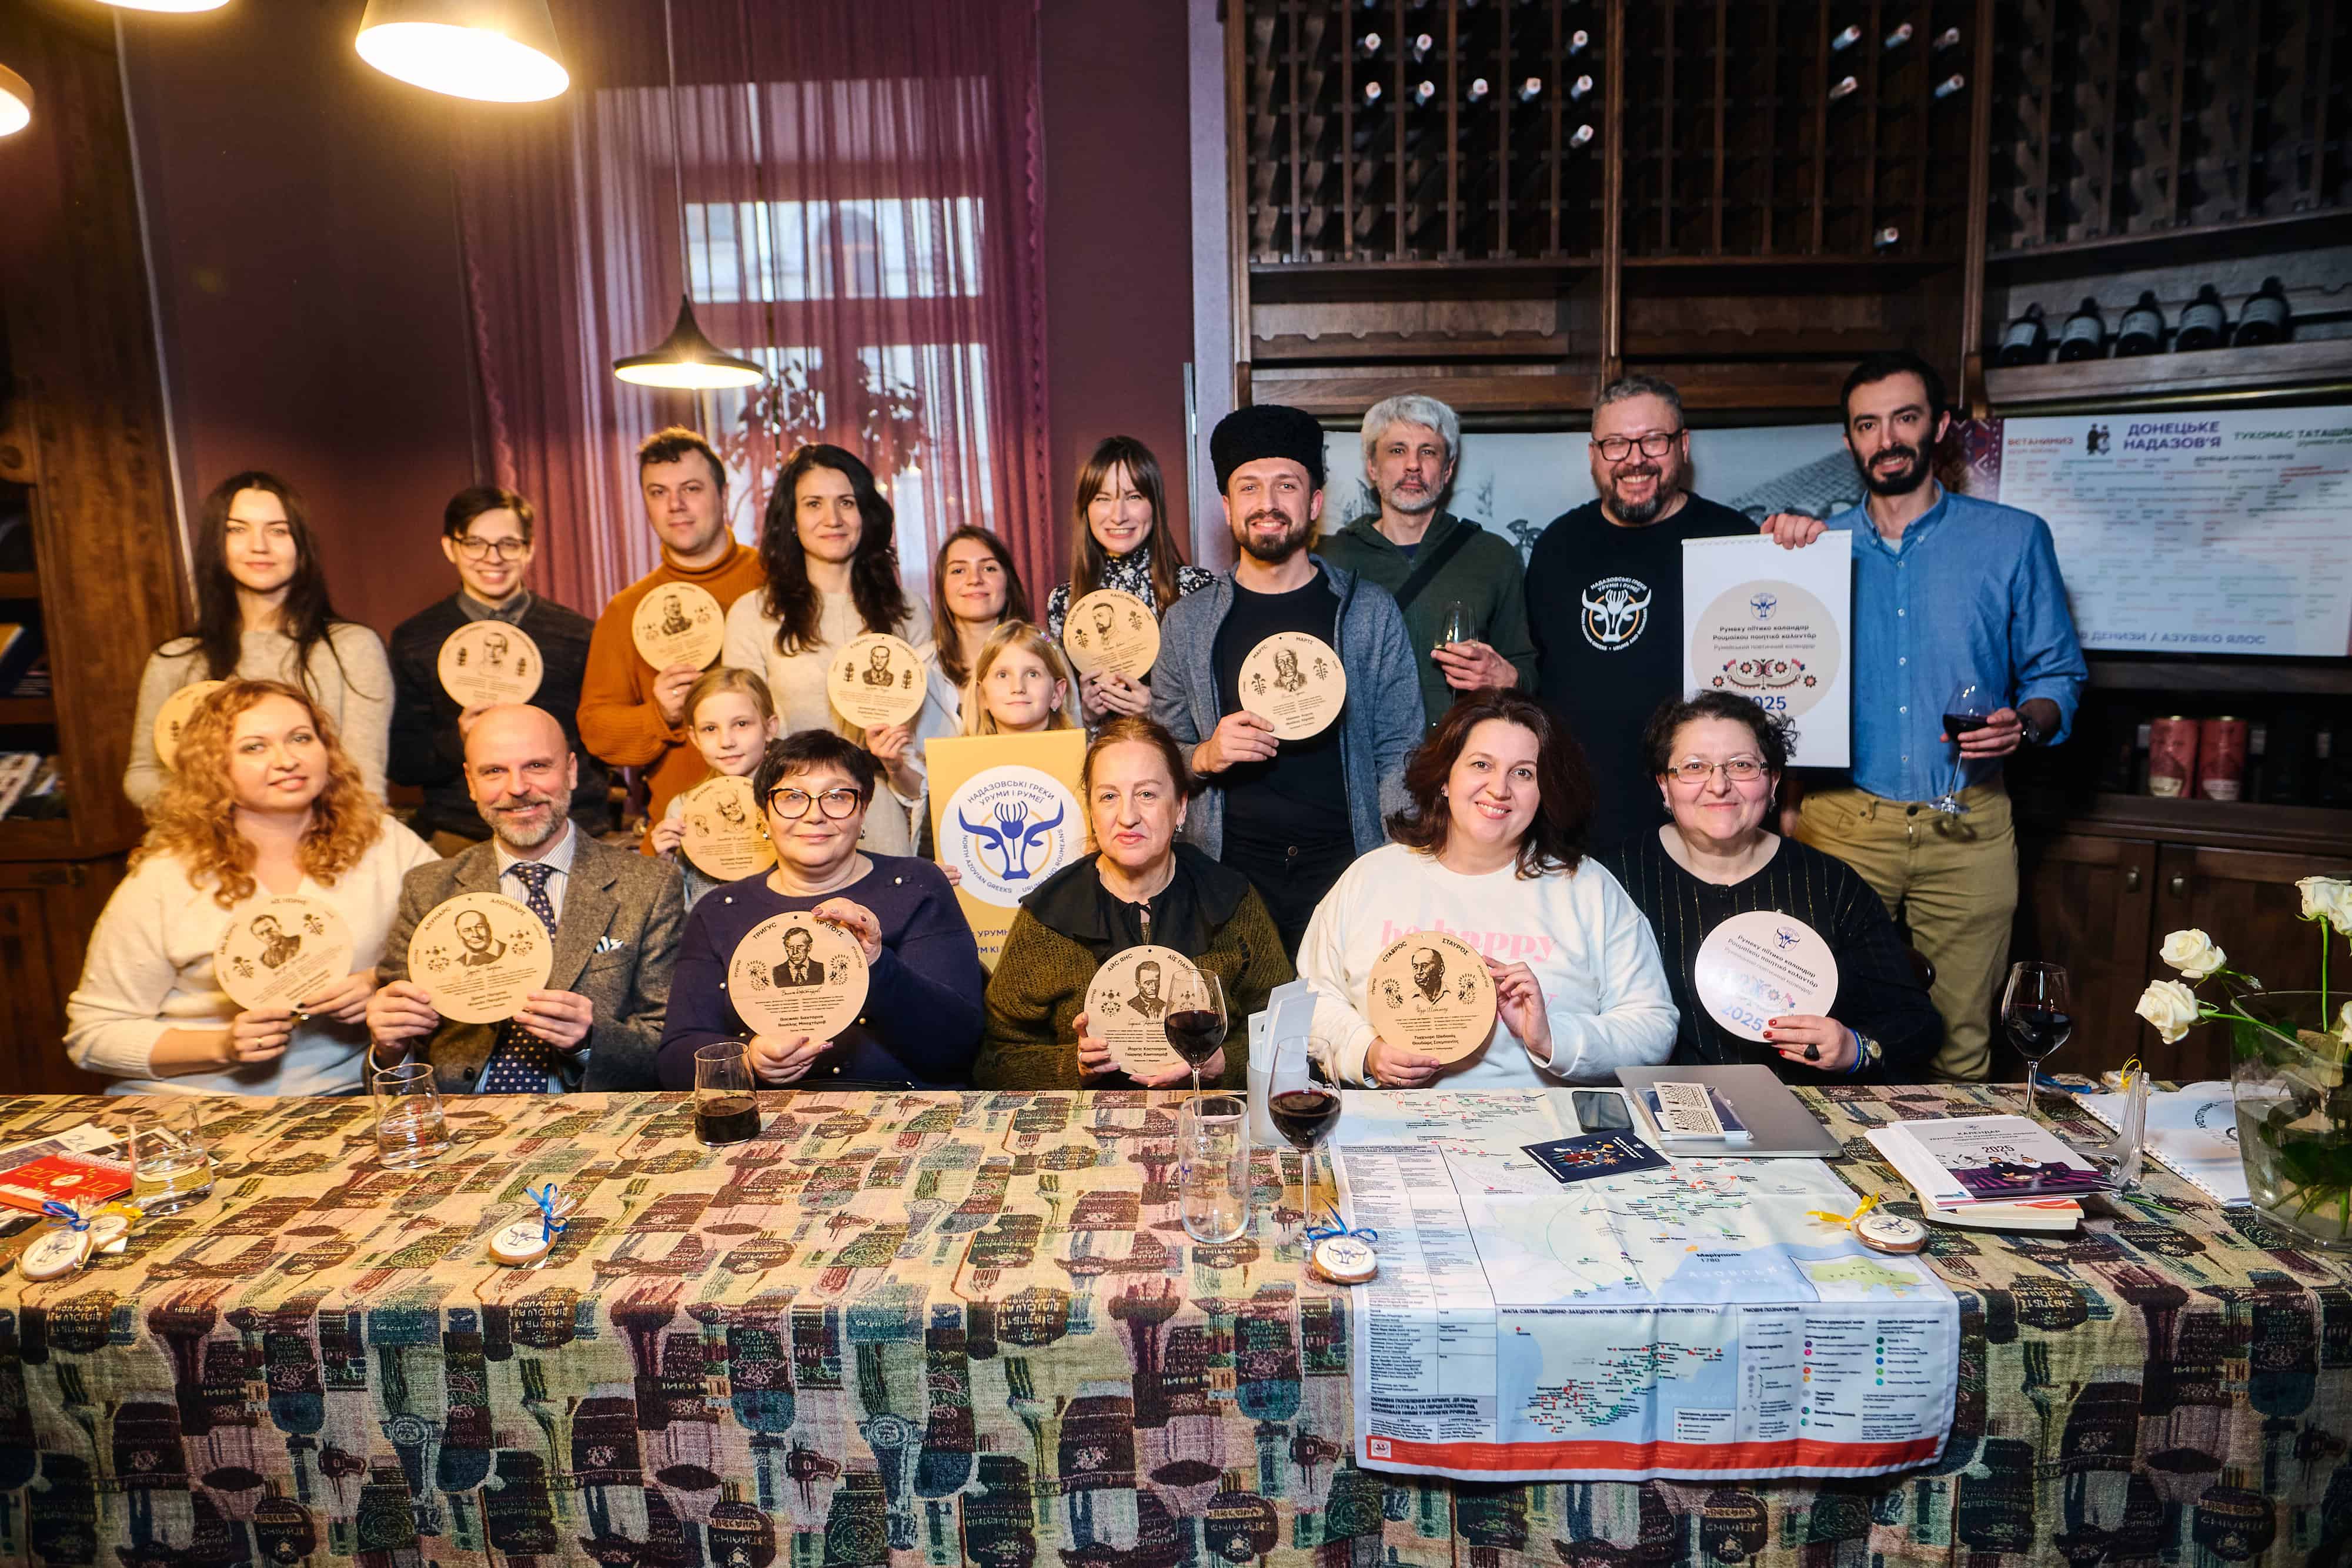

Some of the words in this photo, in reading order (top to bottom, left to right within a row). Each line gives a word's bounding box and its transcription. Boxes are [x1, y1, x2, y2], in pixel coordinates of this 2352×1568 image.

[2128, 421, 2221, 436] ДОНЕЦЬКЕ
[2124, 437, 2221, 450] НАДАЗОВ'Я
[967, 780, 1027, 805] НАДАЗОВСЬКІ
[1029, 783, 1055, 801] ГРЕКИ
[979, 790, 1010, 806] УРУМИ
[1017, 790, 1045, 805] РУМЕЇ
[1055, 828, 1064, 867] ROUMEANS
[966, 859, 987, 885] AZOVIAN
[986, 881, 1013, 894] GREEKS
[753, 922, 777, 940] ТРИГУС
[1382, 941, 1407, 962] СТАВРОС
[1442, 938, 1469, 957] ΣΤΑΥΡΟΣ
[1107, 959, 1120, 972] АЙС
[1120, 953, 1133, 963] ЯНС
[1720, 1005, 1764, 1032] 2025
[1981, 1145, 2015, 1153] 2025
